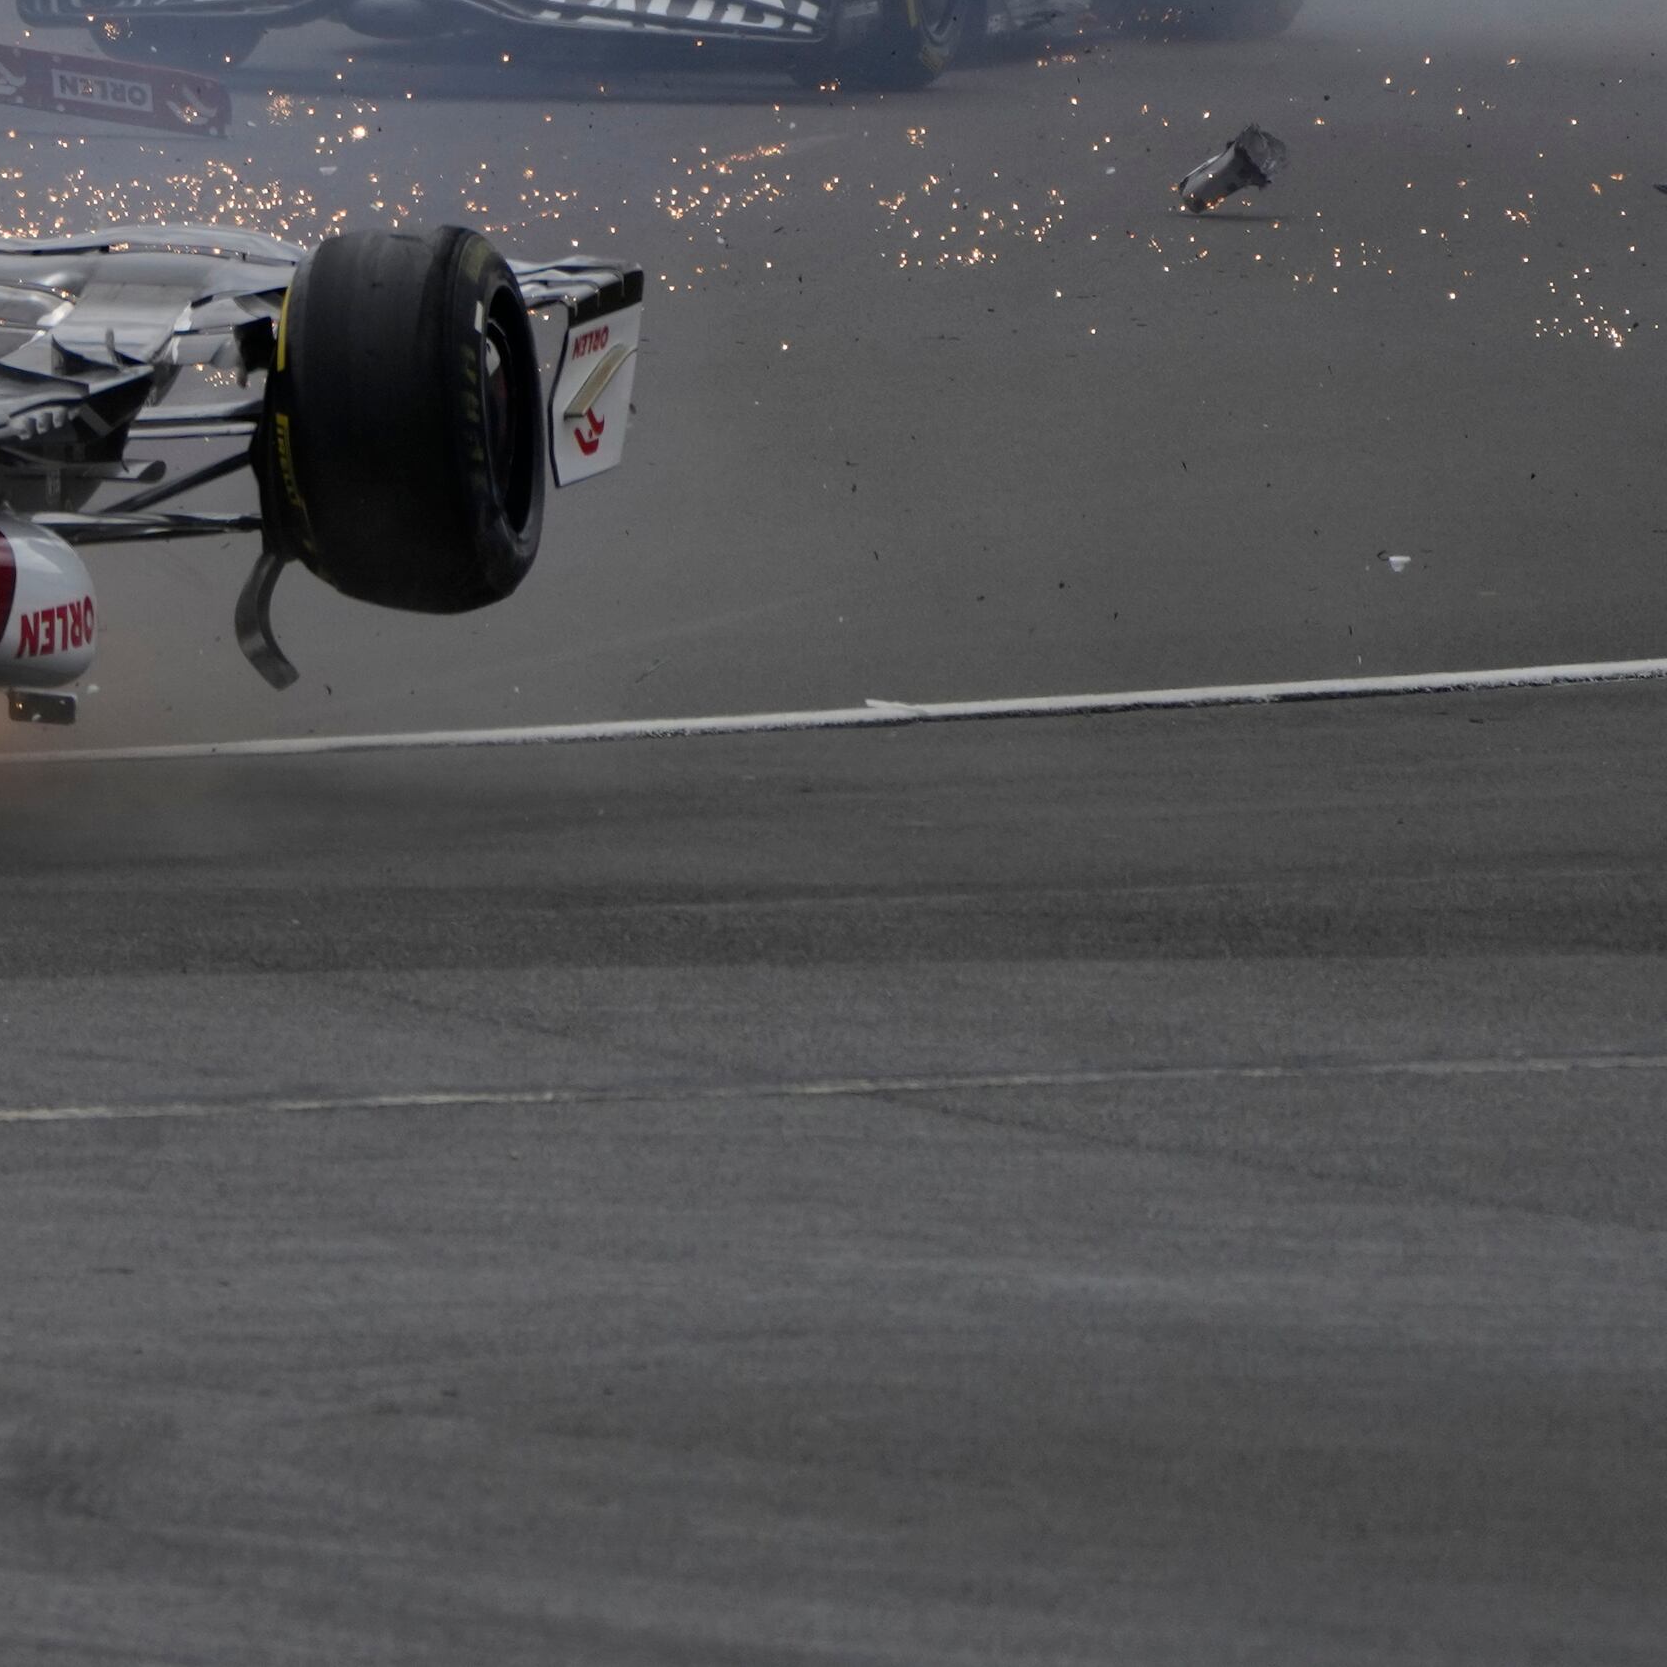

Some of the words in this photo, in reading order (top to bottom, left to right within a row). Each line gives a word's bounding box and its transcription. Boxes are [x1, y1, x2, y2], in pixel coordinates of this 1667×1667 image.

[57, 74, 147, 106] ORLEN
[572, 325, 610, 361] ORLEN
[16, 594, 95, 659] ORLEN
